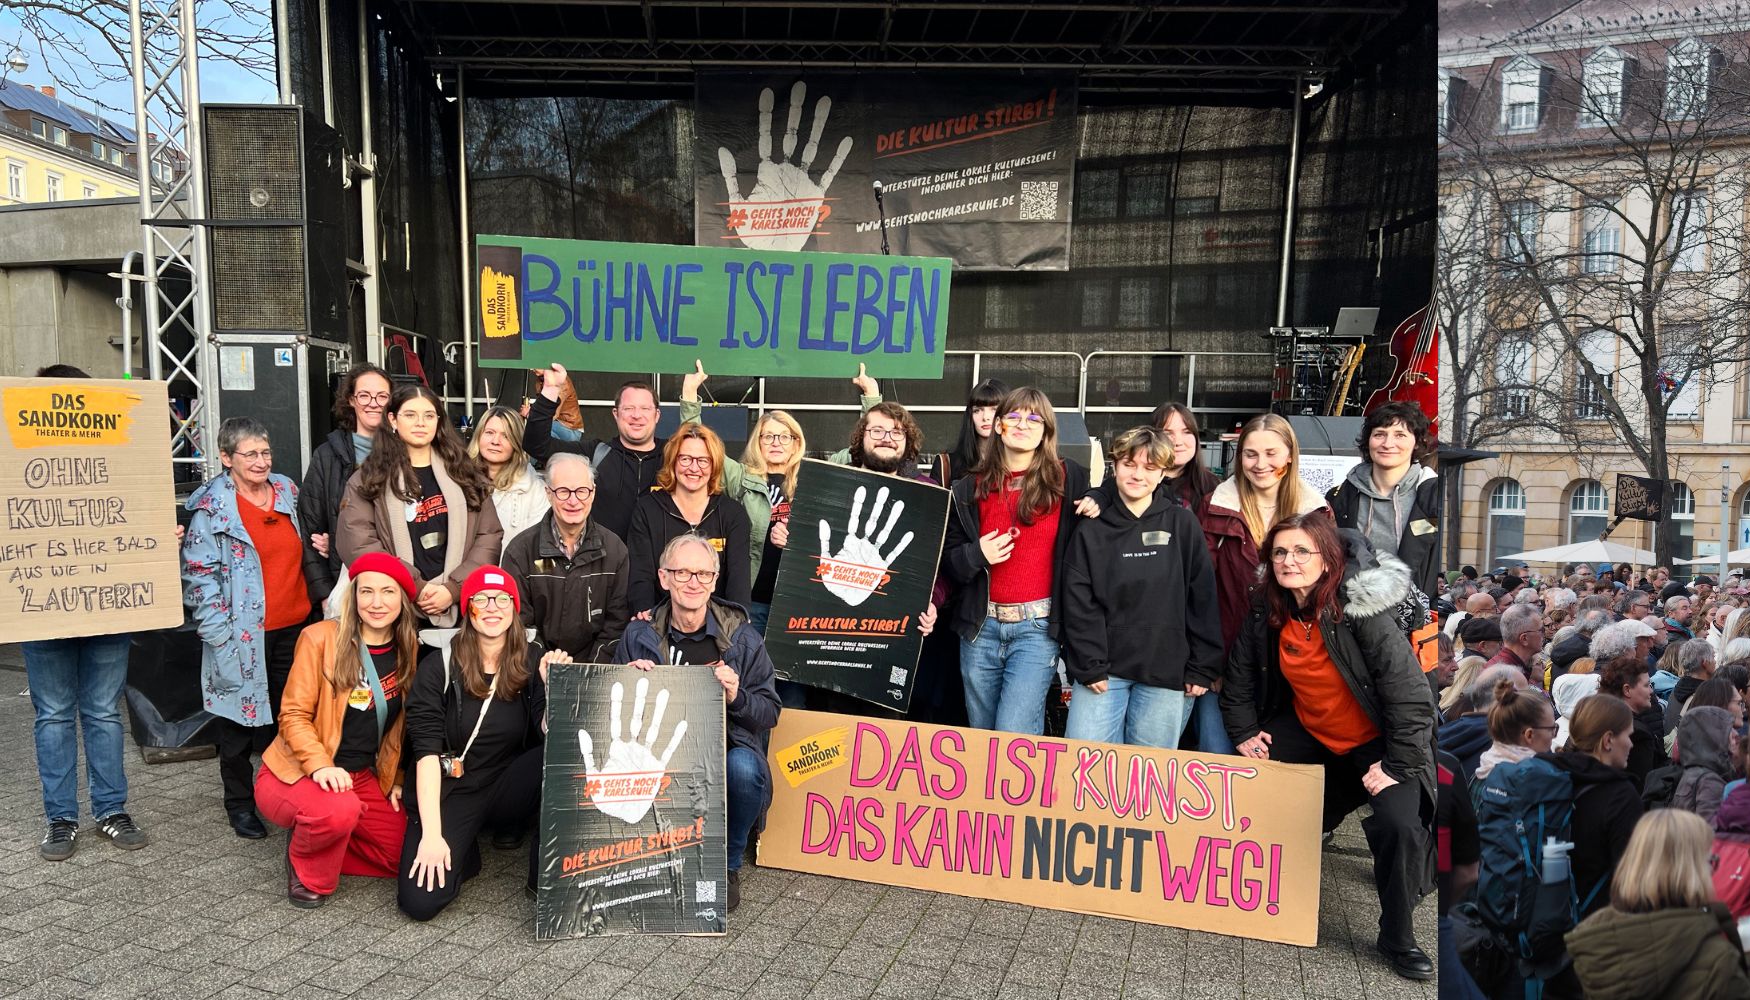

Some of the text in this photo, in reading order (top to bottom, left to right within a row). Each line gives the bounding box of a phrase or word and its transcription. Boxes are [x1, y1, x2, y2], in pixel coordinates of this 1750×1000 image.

[877, 88, 1057, 153] DIE KULTUR STIRBT!
[882, 151, 1057, 194] NTERSTÜTZE DEINE LOKALE KULTURSZENE!
[921, 171, 1014, 196] INFORMIER DICH HIER:
[786, 206, 815, 218] NOCH
[487, 297, 496, 315] DAS
[521, 254, 941, 355] BÜHNE IST LEBEN
[52, 393, 85, 411] DAS
[36, 429, 70, 437] THEATER
[25, 457, 109, 489] OHNE
[7, 496, 127, 530] KULTUR
[47, 539, 68, 558] ES
[72, 537, 108, 556] HIER
[114, 536, 157, 554] BALD
[9, 563, 107, 583] AUS WIE IN
[858, 569, 880, 580] NOCH
[788, 615, 910, 633] DIE KULTUR STIRBT!
[800, 740, 820, 756] DAS
[849, 722, 967, 801] DAS
[985, 737, 1068, 808] IST
[633, 777, 657, 787] NOCH
[562, 853, 586, 872] DIE
[588, 837, 643, 866] KULTUR
[801, 792, 1282, 916] DAS KANN NICHT WEG!
